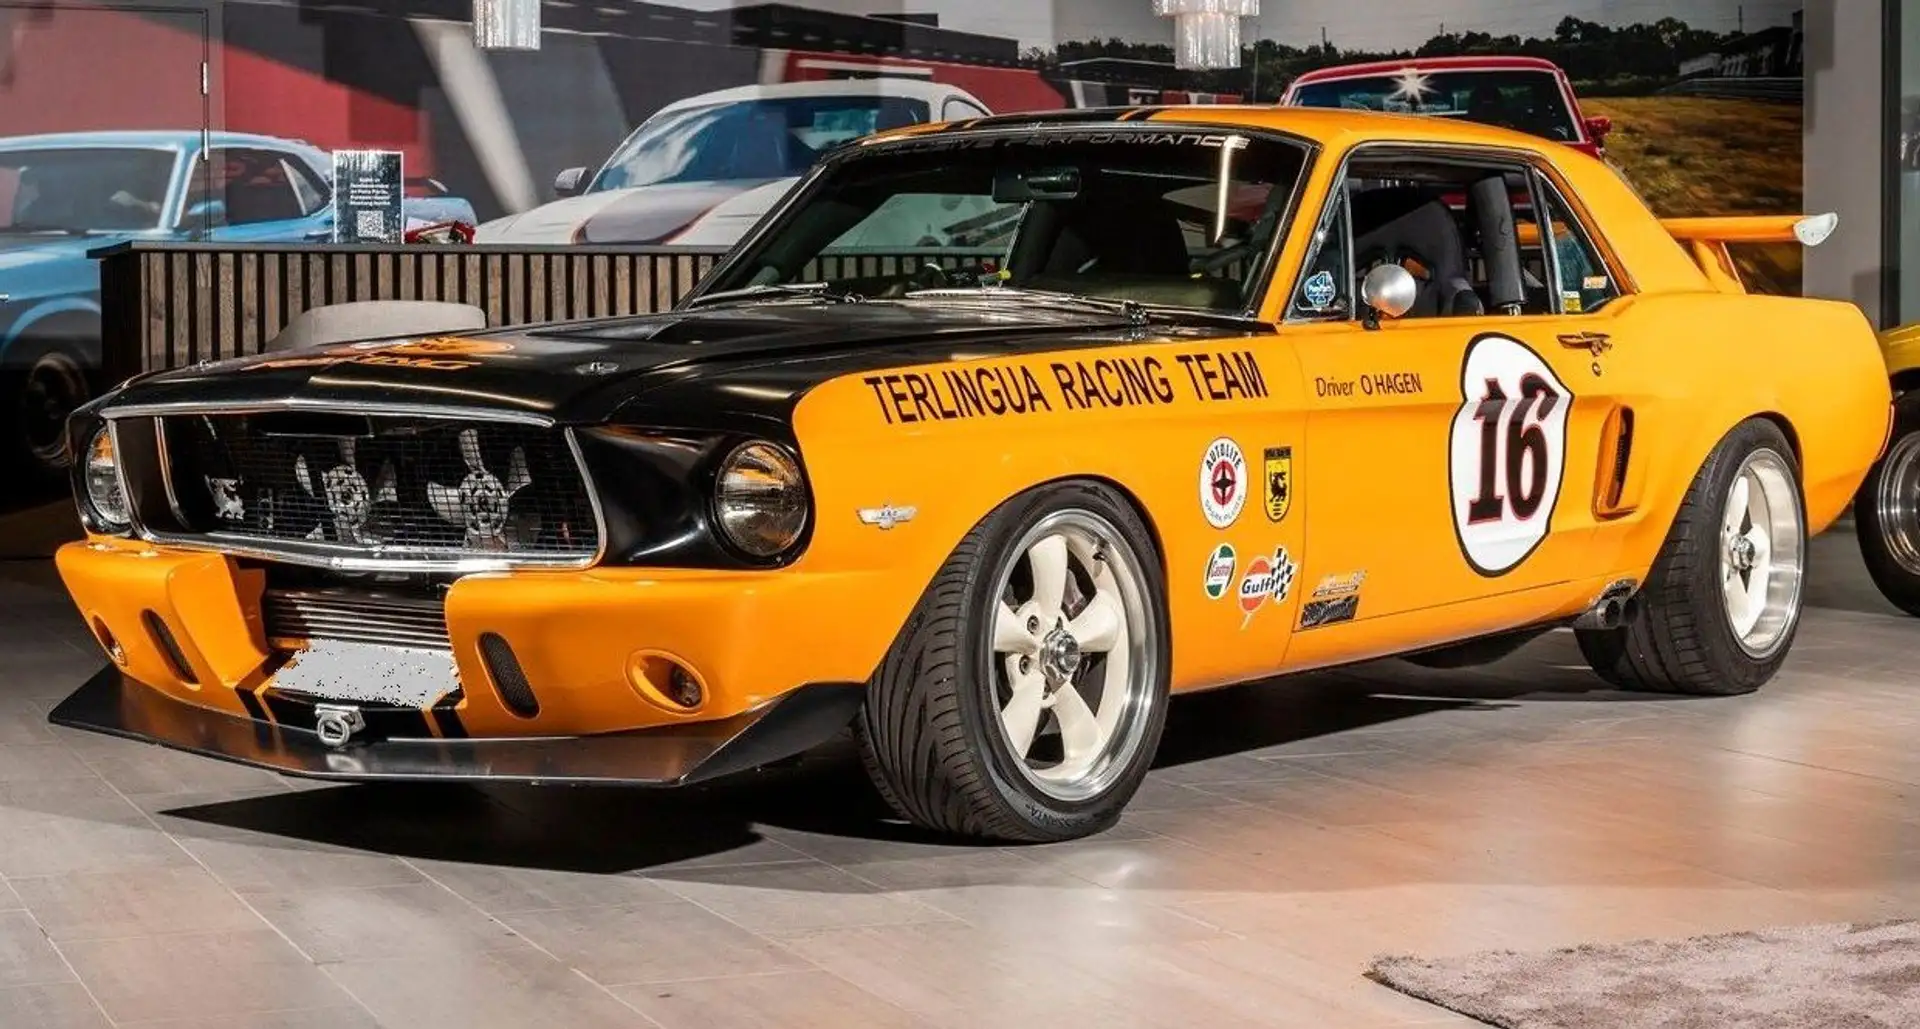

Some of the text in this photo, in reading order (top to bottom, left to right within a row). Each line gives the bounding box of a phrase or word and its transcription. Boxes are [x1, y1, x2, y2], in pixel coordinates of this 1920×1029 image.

[863, 351, 1269, 424] TERLINGUA RACING TEAM
[1315, 376, 1355, 397] Driver
[1374, 372, 1423, 394] HAGEN
[1206, 442, 1242, 472] AUTOLITE
[1467, 372, 1560, 525] 16
[1242, 577, 1272, 594] Gulf
